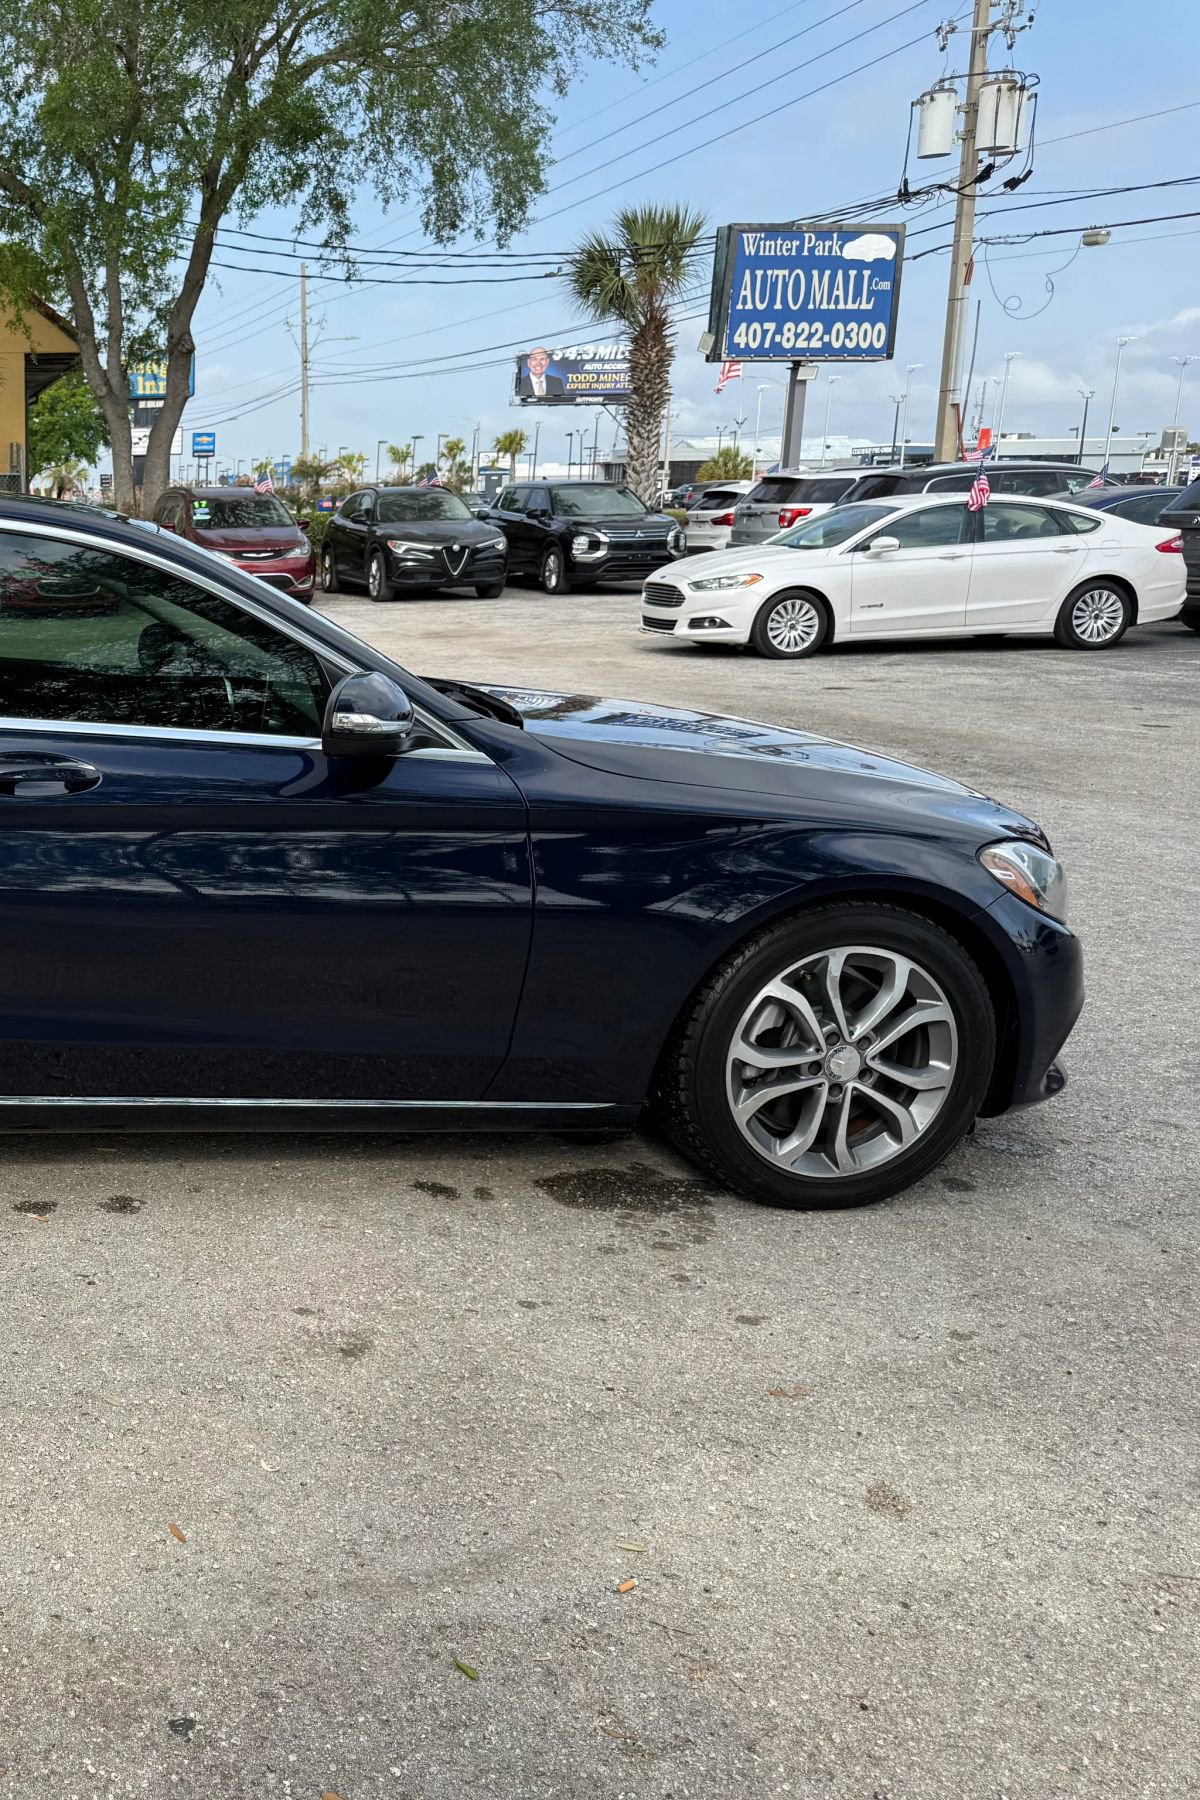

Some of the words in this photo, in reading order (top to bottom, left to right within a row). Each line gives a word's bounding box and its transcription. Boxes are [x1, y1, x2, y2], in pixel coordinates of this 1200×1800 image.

[742, 232, 800, 256] Winter
[802, 232, 842, 256] Park
[736, 268, 806, 311] AUTO
[808, 269, 875, 310] MALL
[870, 277, 891, 291] .Com
[733, 321, 887, 349] 407-822-0300
[567, 373, 597, 382] TODD
[567, 382, 591, 390] EXPERT
[591, 382, 615, 390] INJURY
[193, 500, 208, 508] 17
